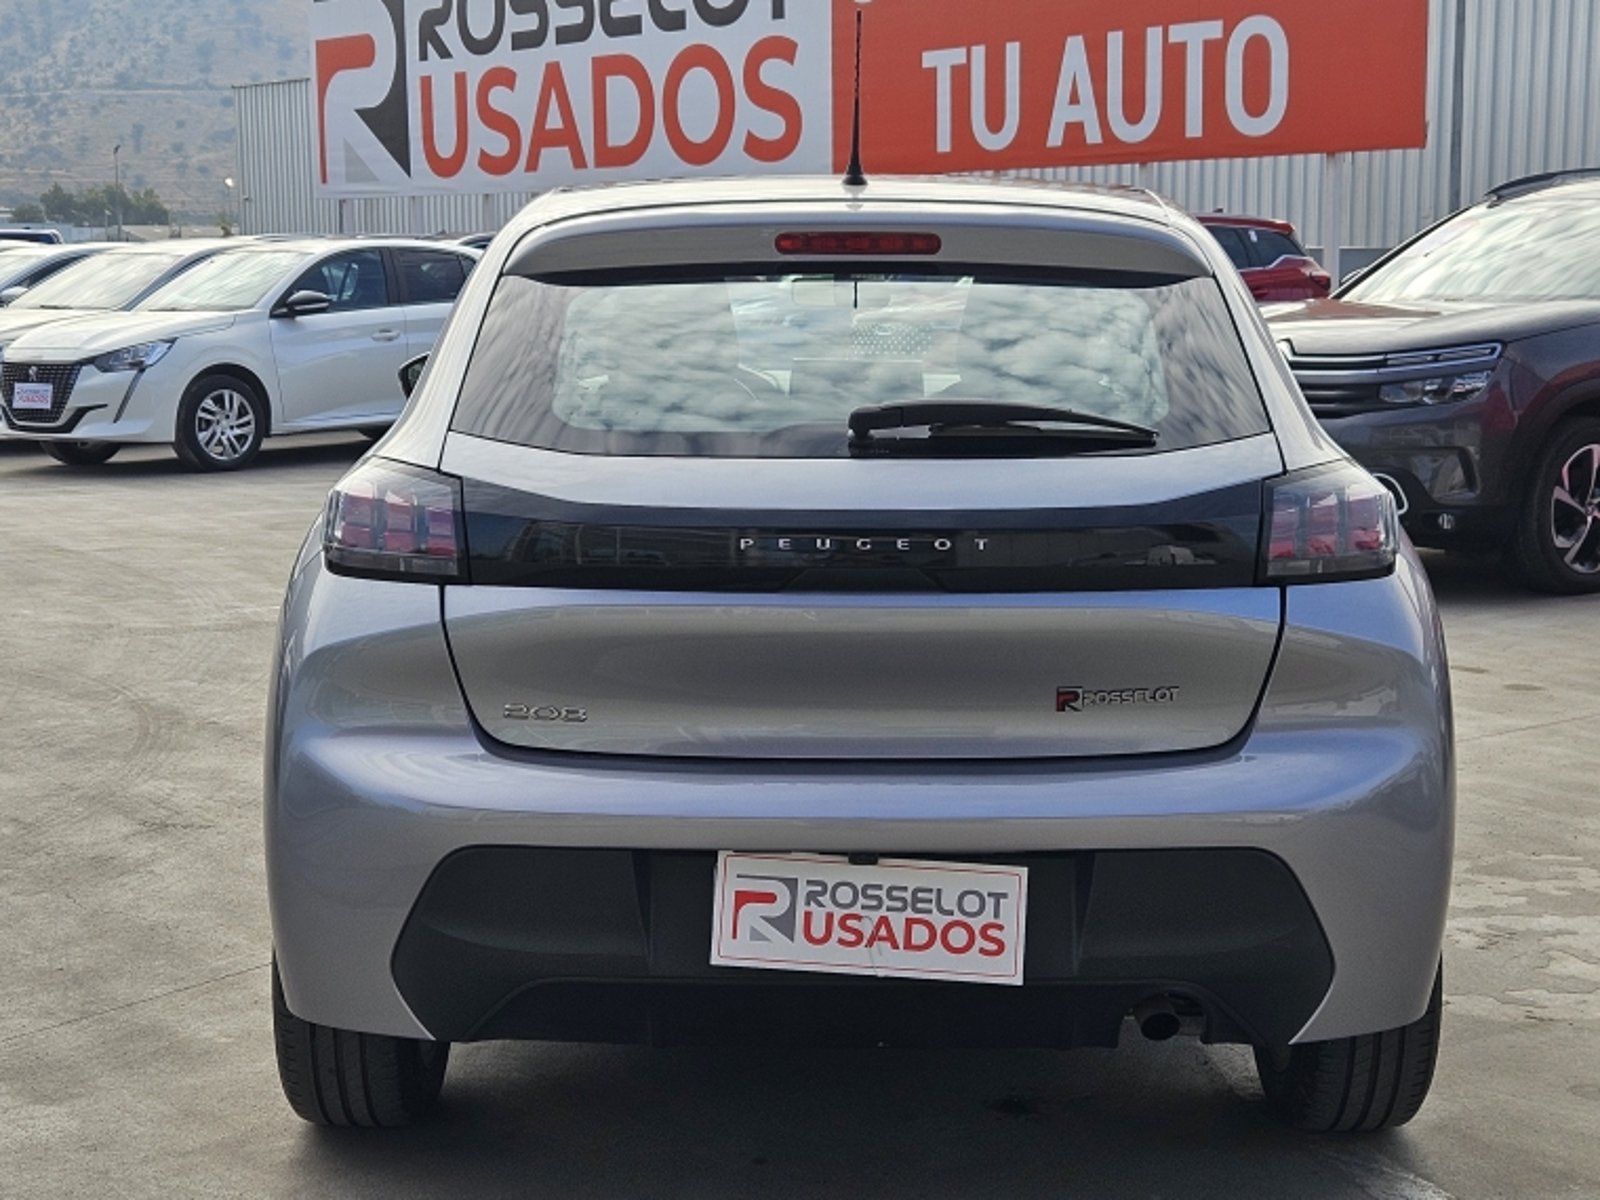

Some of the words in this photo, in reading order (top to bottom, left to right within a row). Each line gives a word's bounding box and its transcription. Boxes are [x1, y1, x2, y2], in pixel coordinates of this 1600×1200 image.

[418, 0, 786, 62] ROSS
[419, 35, 803, 178] USADOS
[921, 41, 1021, 154] TU
[1046, 14, 1290, 148] AUTO
[739, 537, 989, 551] PEUGEOT
[804, 879, 1009, 919] ROSSELOT
[803, 911, 1006, 957] USADOS
